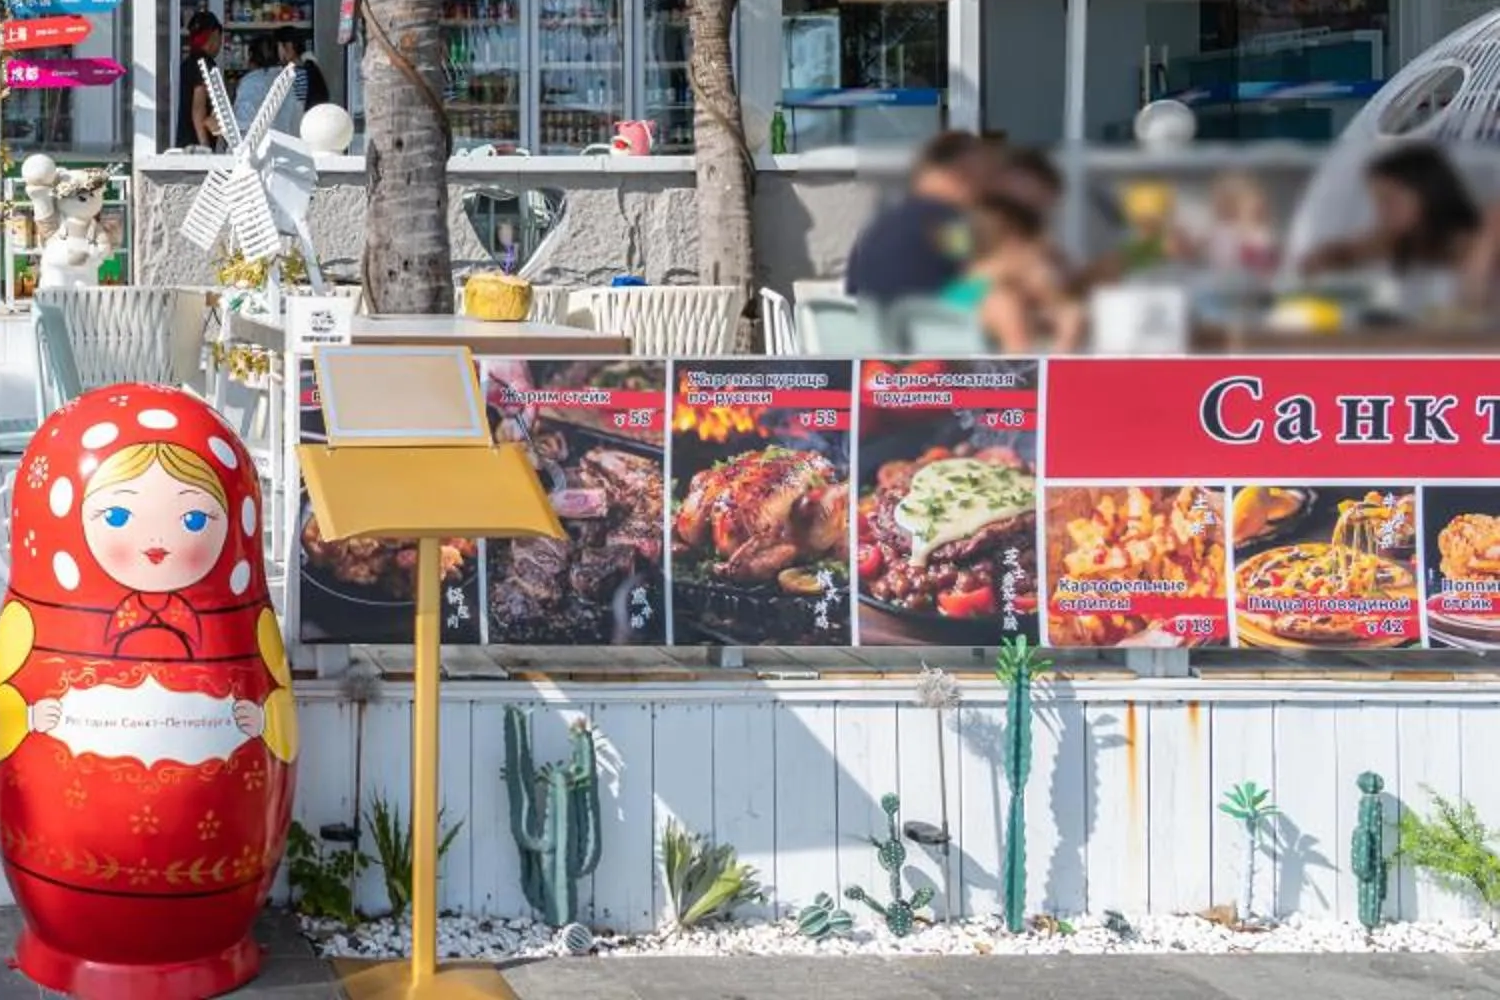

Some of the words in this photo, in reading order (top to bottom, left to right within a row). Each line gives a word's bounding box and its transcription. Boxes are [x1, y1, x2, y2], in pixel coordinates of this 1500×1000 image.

[6, 26, 28, 43] 上海
[10, 66, 40, 81] 成都
[1058, 578, 1187, 594] Картофельные
[1248, 596, 1304, 613] Пицца
[1317, 596, 1412, 614] говядиной
